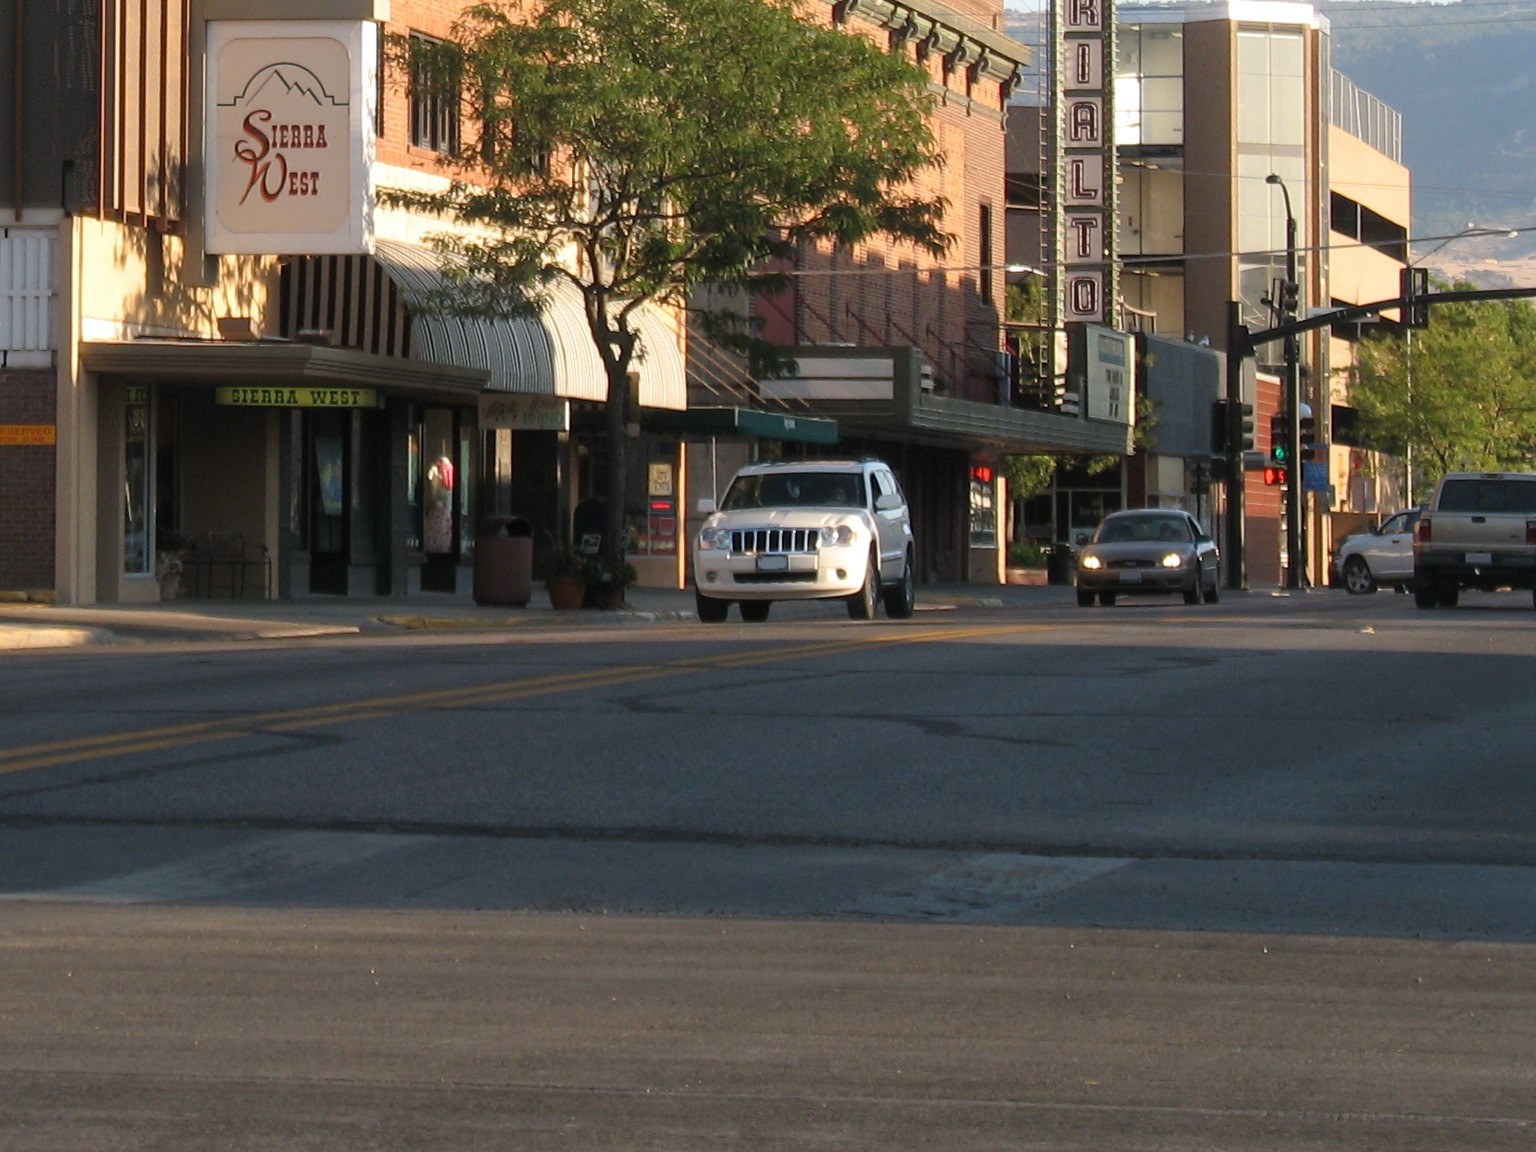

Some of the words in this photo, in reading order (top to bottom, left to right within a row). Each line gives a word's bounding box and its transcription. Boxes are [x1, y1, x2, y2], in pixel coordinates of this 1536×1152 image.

[235, 109, 328, 162] SIERRA
[232, 148, 320, 206] WEST
[231, 388, 298, 405] SIERRA
[310, 390, 360, 406] WEST
